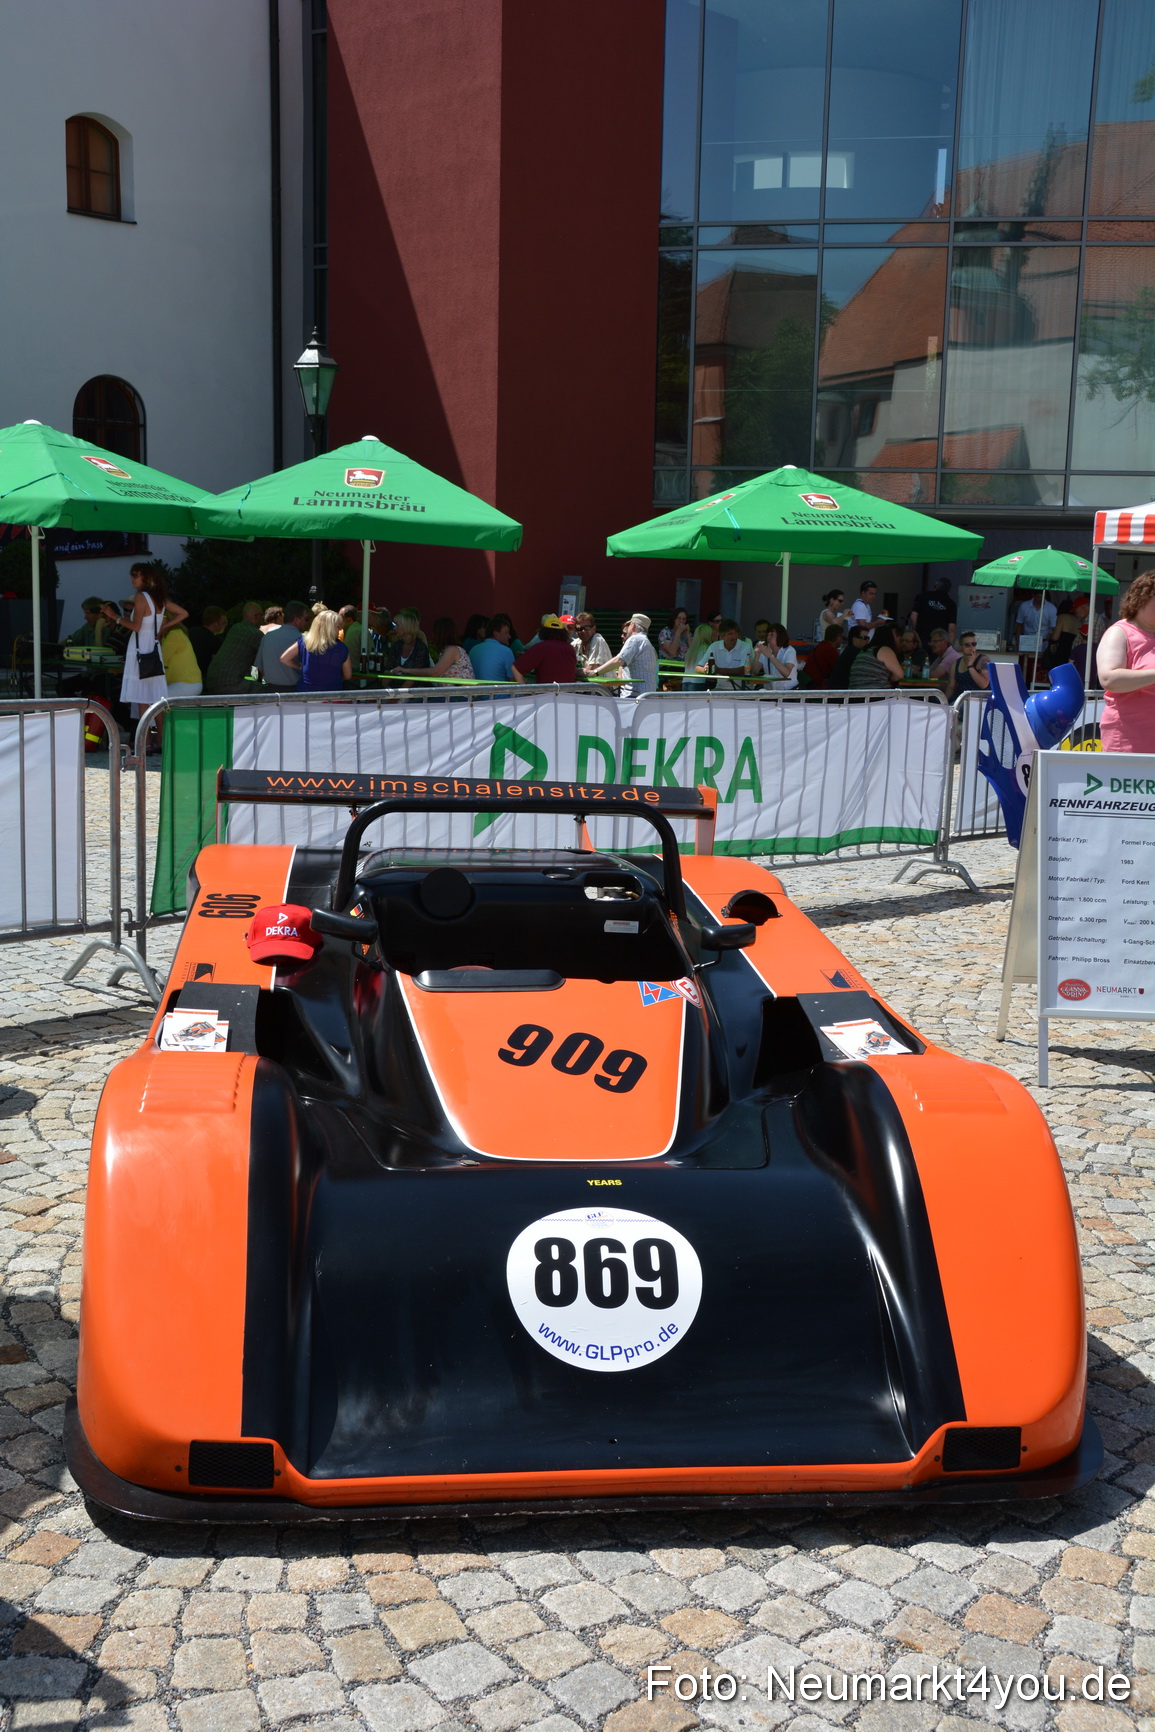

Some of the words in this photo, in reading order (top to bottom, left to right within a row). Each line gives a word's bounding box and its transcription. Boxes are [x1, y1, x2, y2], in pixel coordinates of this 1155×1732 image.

[313, 490, 411, 502] Neumarkter
[293, 496, 426, 513] Lammsbräu
[780, 516, 897, 530] Lammsbräu
[791, 511, 873, 522] Neumarkter
[576, 734, 763, 804] DEKRA
[265, 775, 661, 802] www.imschalensitz.de
[1122, 898, 1149, 906] Leistung:
[265, 925, 298, 937] DEKRA
[1077, 936, 1107, 945] Schaltung:
[1096, 985, 1137, 995] NEUMARKT
[497, 1023, 648, 1094] 909
[534, 1236, 680, 1310] 869
[538, 1322, 679, 1363] www.GLPpro.de
